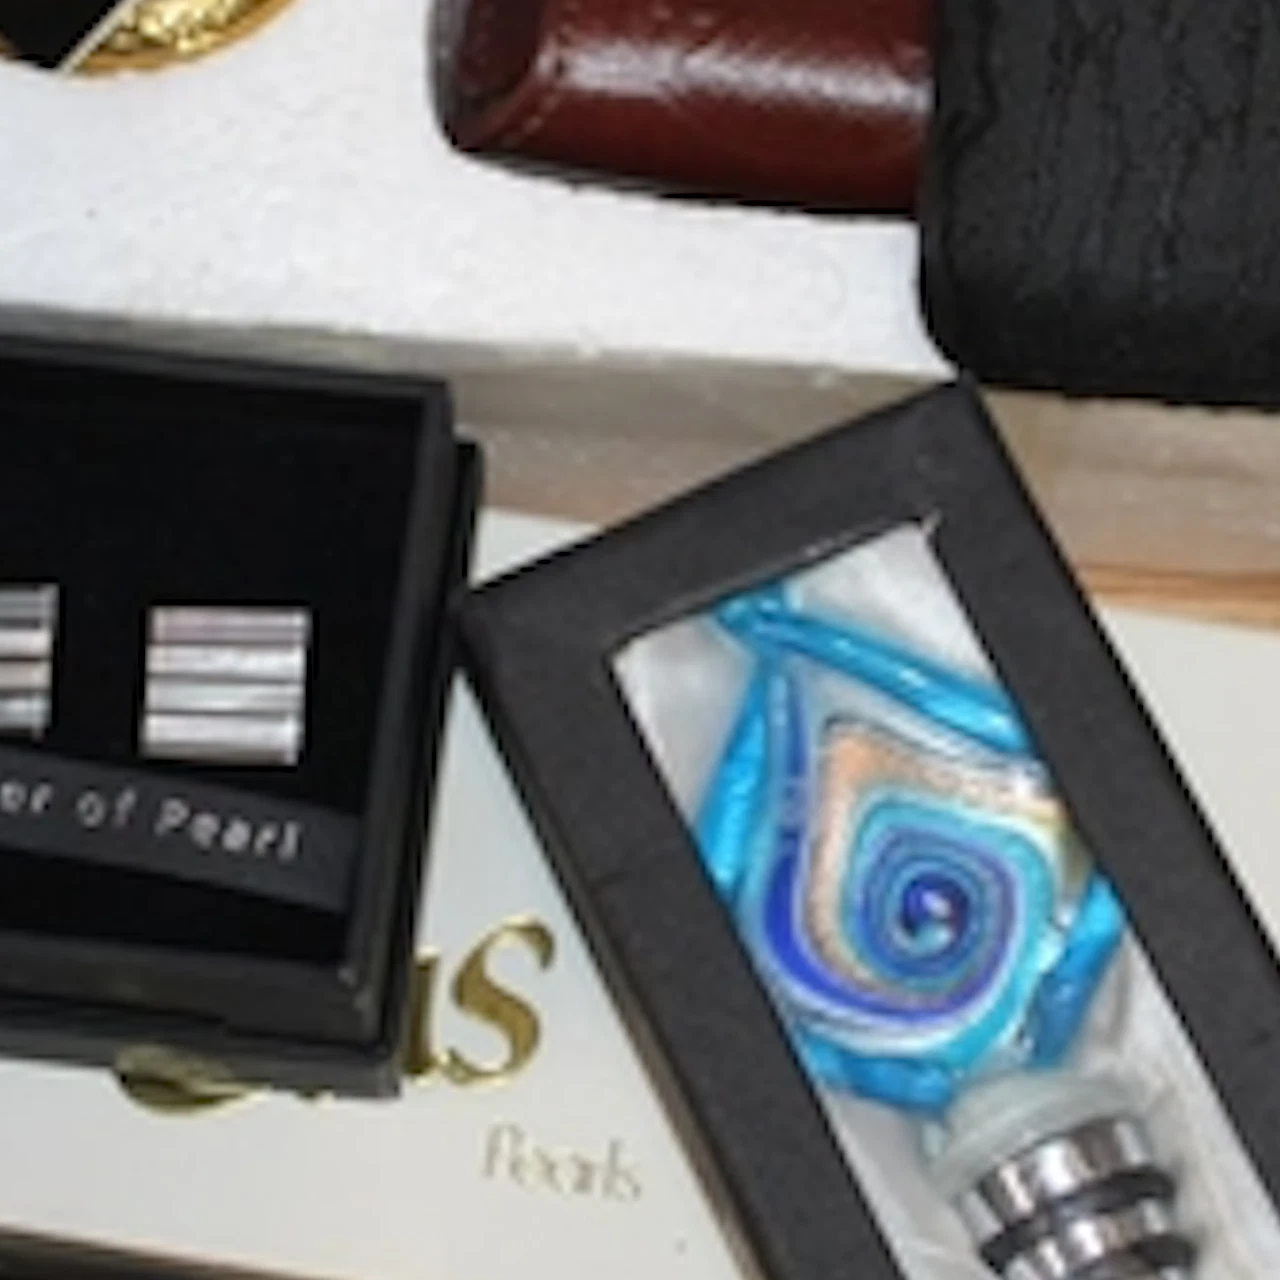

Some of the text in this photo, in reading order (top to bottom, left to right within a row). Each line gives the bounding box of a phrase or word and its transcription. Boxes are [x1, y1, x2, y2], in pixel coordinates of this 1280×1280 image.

[75, 788, 136, 831] of
[154, 798, 304, 860] Pearl
[481, 1121, 642, 1202] Pearls
